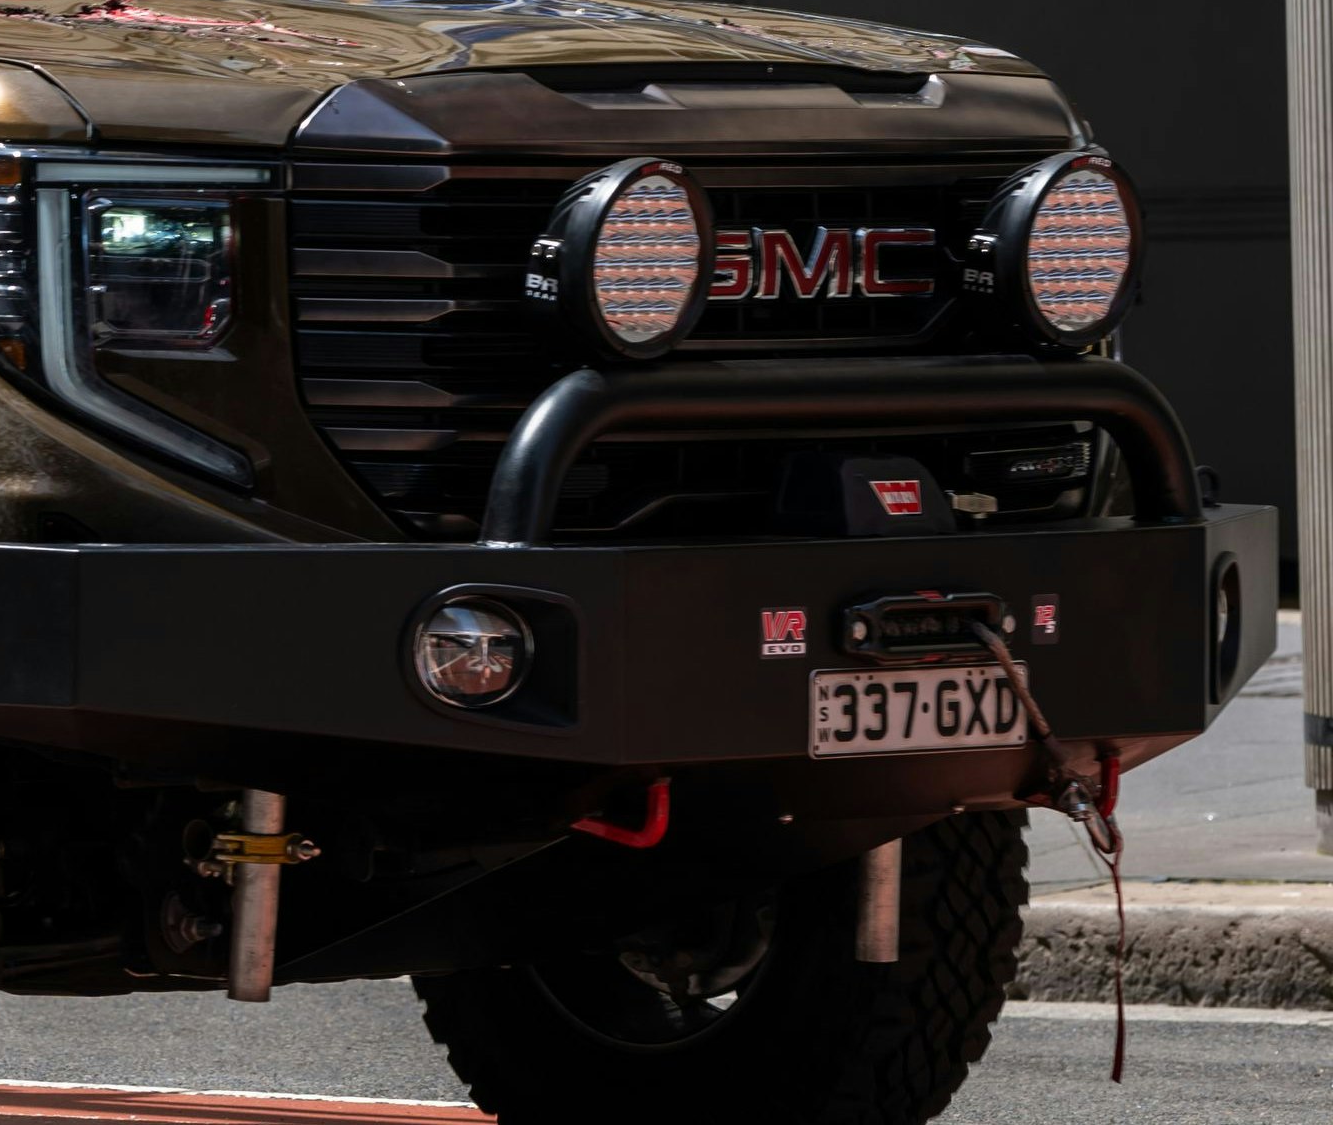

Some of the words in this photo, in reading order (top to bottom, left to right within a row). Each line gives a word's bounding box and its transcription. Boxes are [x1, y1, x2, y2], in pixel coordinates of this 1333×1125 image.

[706, 225, 936, 301] GMC
[524, 273, 559, 293] BR
[964, 268, 995, 286] BR
[761, 610, 807, 641] VR
[766, 644, 802, 654] EVO
